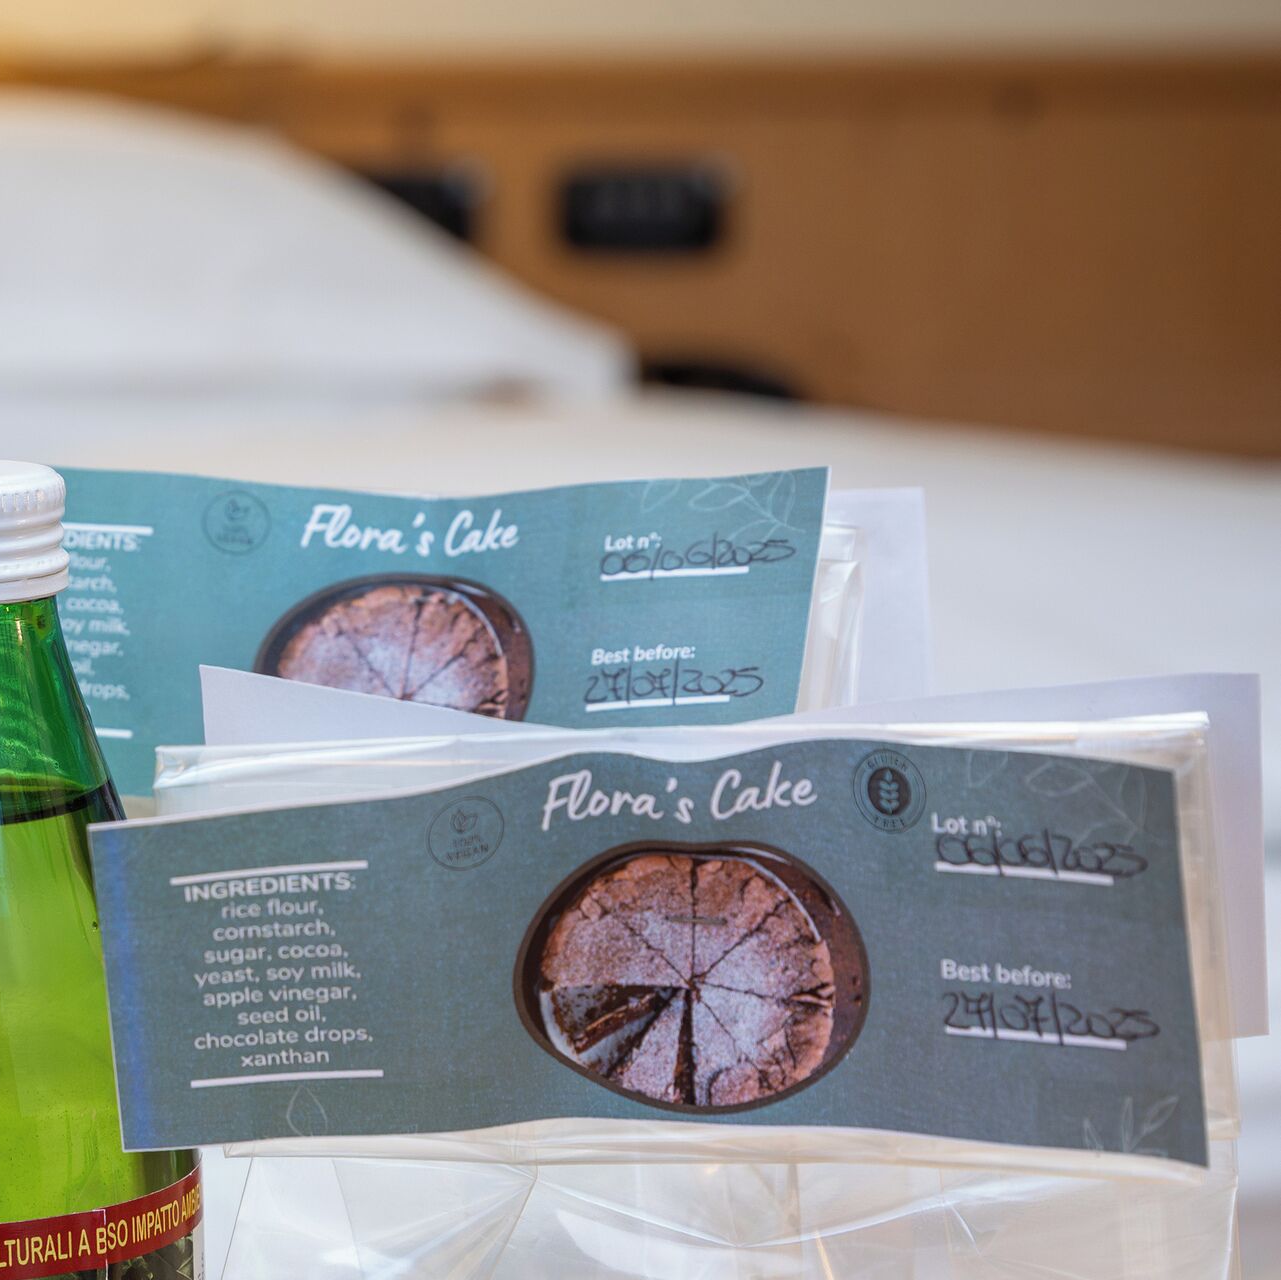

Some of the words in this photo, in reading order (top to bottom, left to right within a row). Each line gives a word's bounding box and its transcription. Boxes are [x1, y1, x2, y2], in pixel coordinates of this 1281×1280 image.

[300, 504, 435, 557] Flora's
[444, 508, 519, 557] Cake
[604, 534, 634, 551] Lot
[591, 648, 631, 665] Best
[633, 644, 696, 662] before:
[541, 768, 695, 832] Flora's
[710, 759, 819, 821] Cake
[931, 812, 969, 834] Lot
[184, 871, 357, 902] INGREDIENTS:
[221, 901, 262, 919] rice
[266, 897, 324, 916] flour,
[212, 919, 336, 942] cornstarch,
[203, 945, 272, 965] sugar,
[277, 942, 349, 959] cocoa,
[193, 966, 261, 988] yeast,
[266, 966, 305, 982] soy
[310, 961, 362, 980] milk,
[940, 958, 991, 984] Best
[994, 963, 1073, 990] before:
[203, 986, 263, 1008] apple
[268, 984, 358, 1003] vinegar,
[237, 1006, 289, 1026] seed
[295, 1004, 327, 1023] oil,
[194, 1028, 299, 1050] chocolate
[304, 1026, 374, 1045] drops,
[241, 1048, 330, 1067] xanthan
[78, 1228, 92, 1257] A
[131, 1199, 180, 1244] IMPATTO
